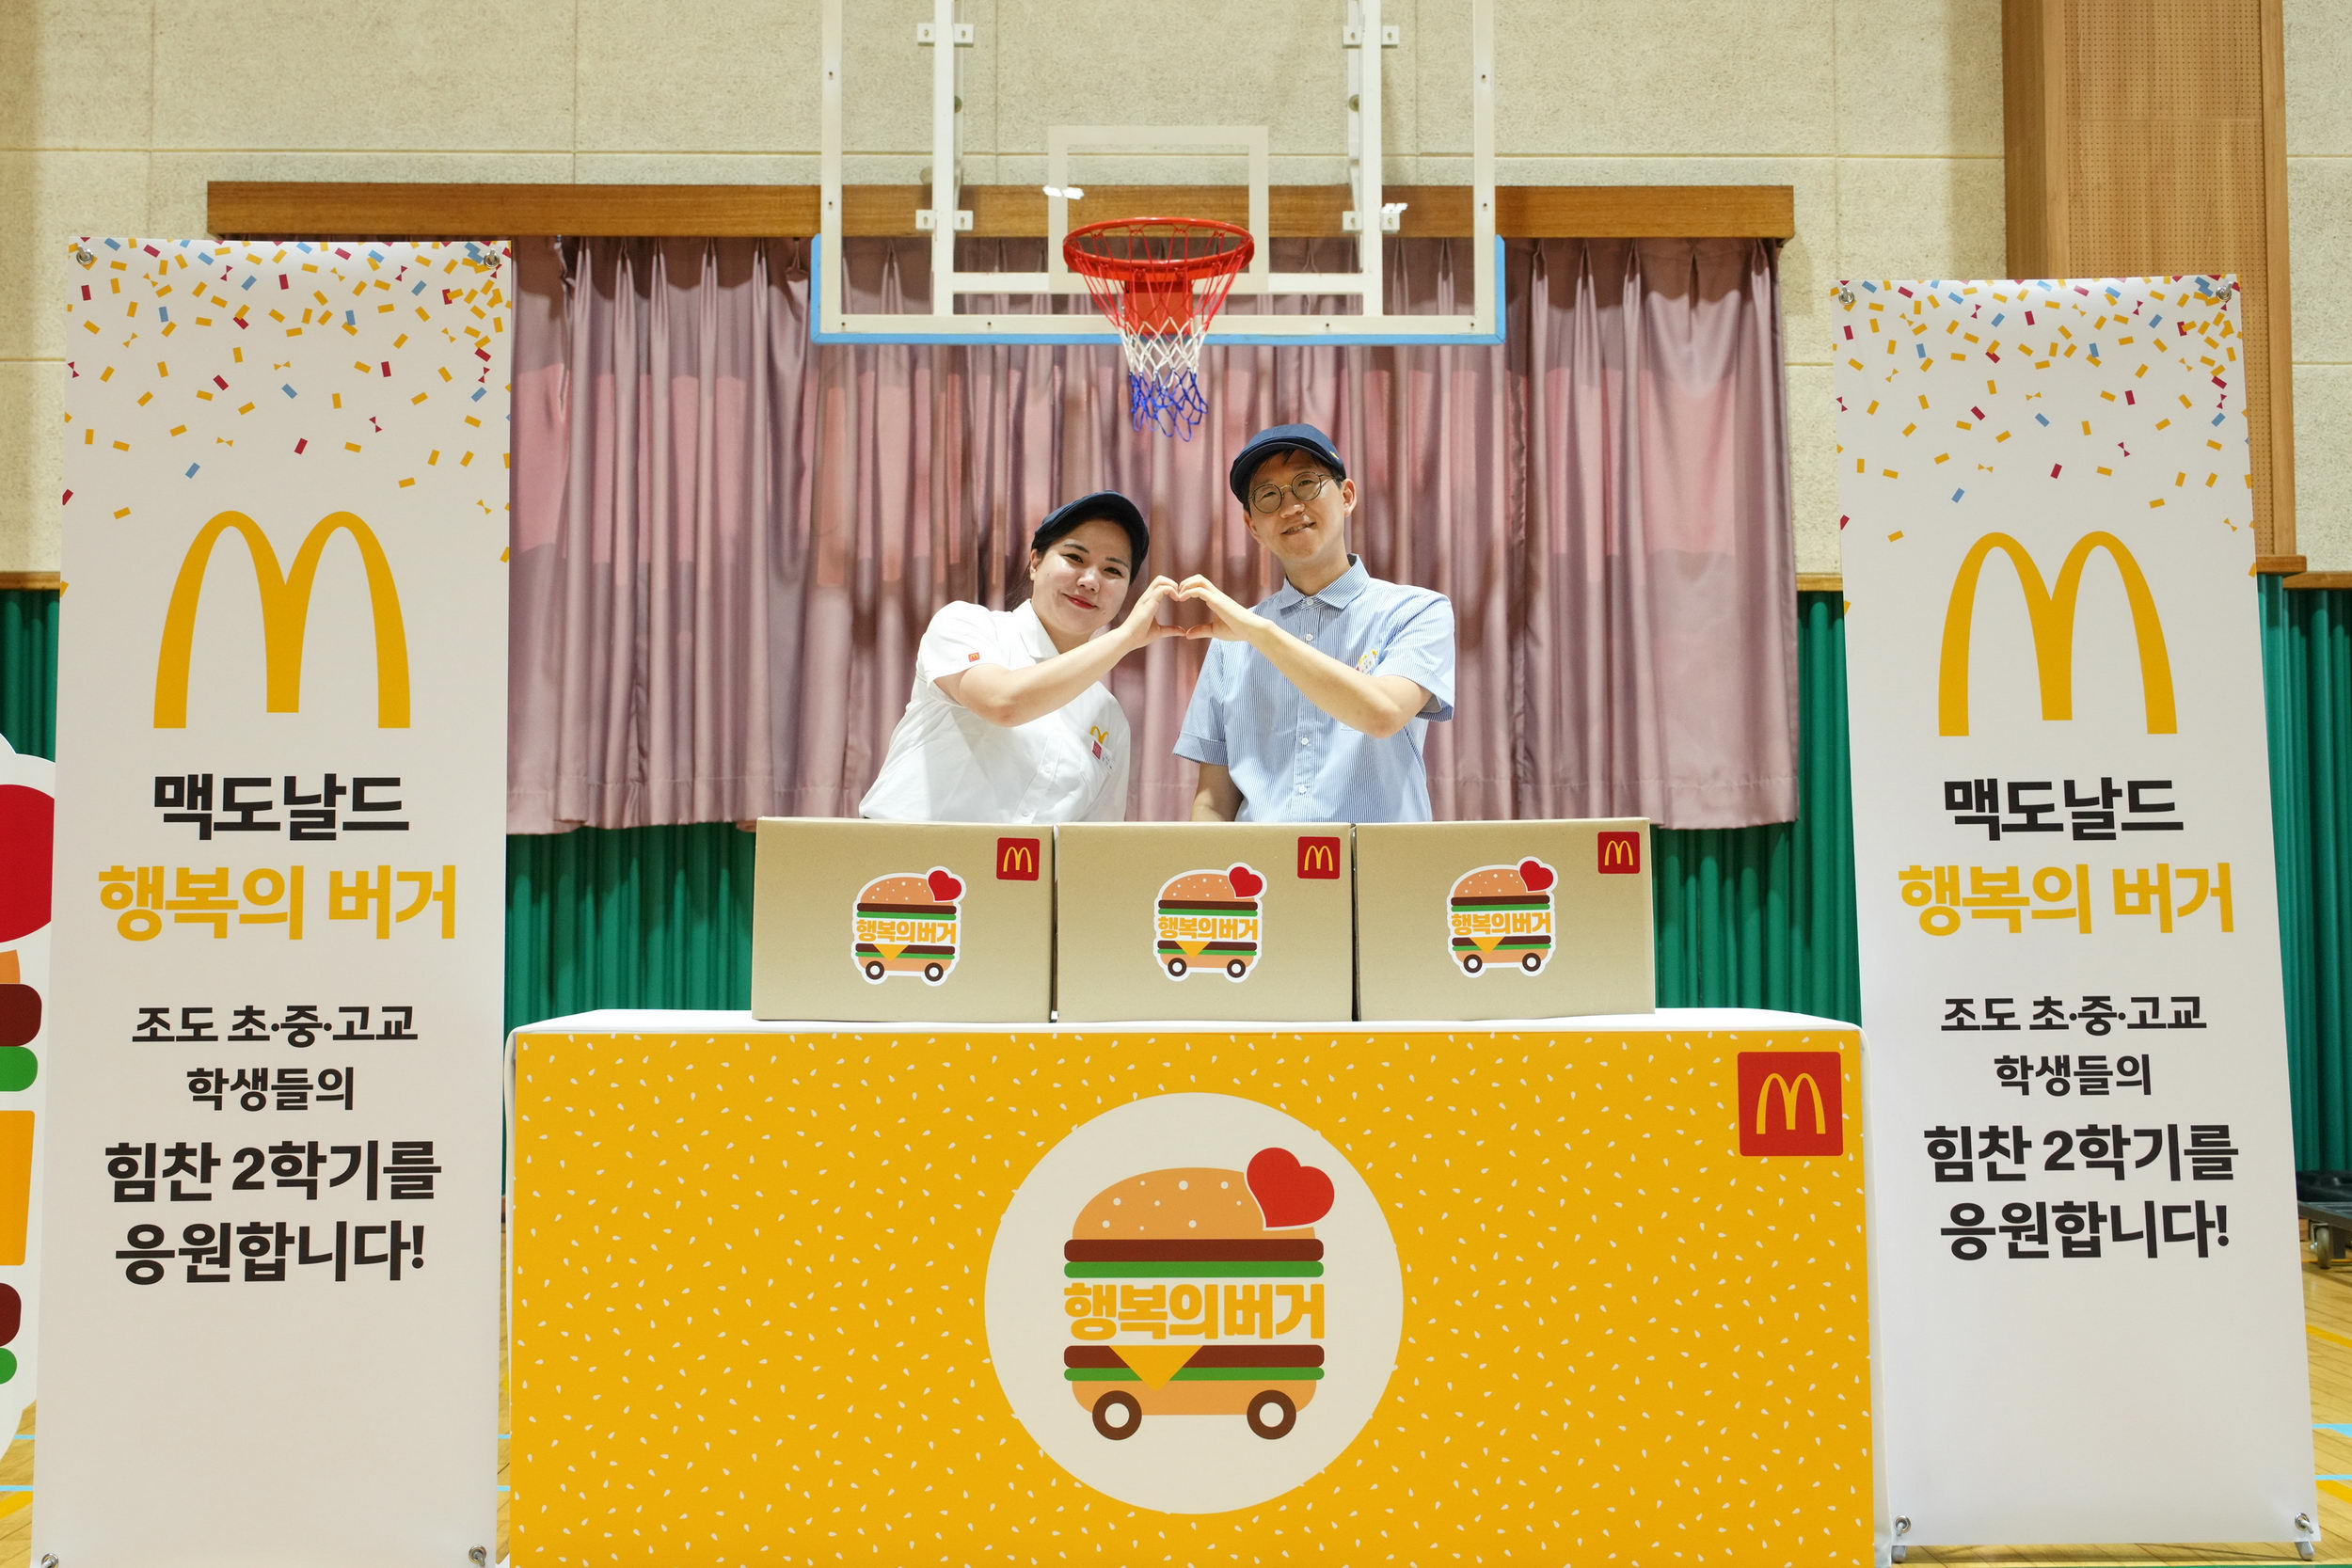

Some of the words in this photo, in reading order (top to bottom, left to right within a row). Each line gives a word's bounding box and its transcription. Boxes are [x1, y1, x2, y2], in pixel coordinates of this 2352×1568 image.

[153, 773, 410, 841] 맥도날드
[1944, 777, 2185, 841] 맥도날드
[98, 864, 304, 942] 행복의
[328, 864, 456, 940] 버거
[1158, 916, 1258, 941] 행복의버거
[1451, 912, 1551, 936] 행복의버거
[1898, 863, 2092, 937] 행복의
[2112, 862, 2234, 933] 버거
[856, 919, 957, 944] 행복의버거
[132, 1006, 218, 1043] 조도
[228, 1005, 419, 1048] 초·중·고교
[1940, 997, 2021, 1032] 조도
[2028, 995, 2207, 1037] 초·중·고교
[186, 1067, 354, 1112] 학생들의
[1994, 1053, 2152, 1097] 학생들의
[104, 1141, 221, 1203] 힘찬
[231, 1140, 442, 1201] 2학기를
[1923, 1125, 2032, 1182] 힘찬
[2043, 1124, 2239, 1182] 2학기를
[115, 1220, 424, 1286] 응원합니다!
[1940, 1199, 2230, 1261] 응원합니다!
[1064, 1282, 1325, 1341] 행복의버거
